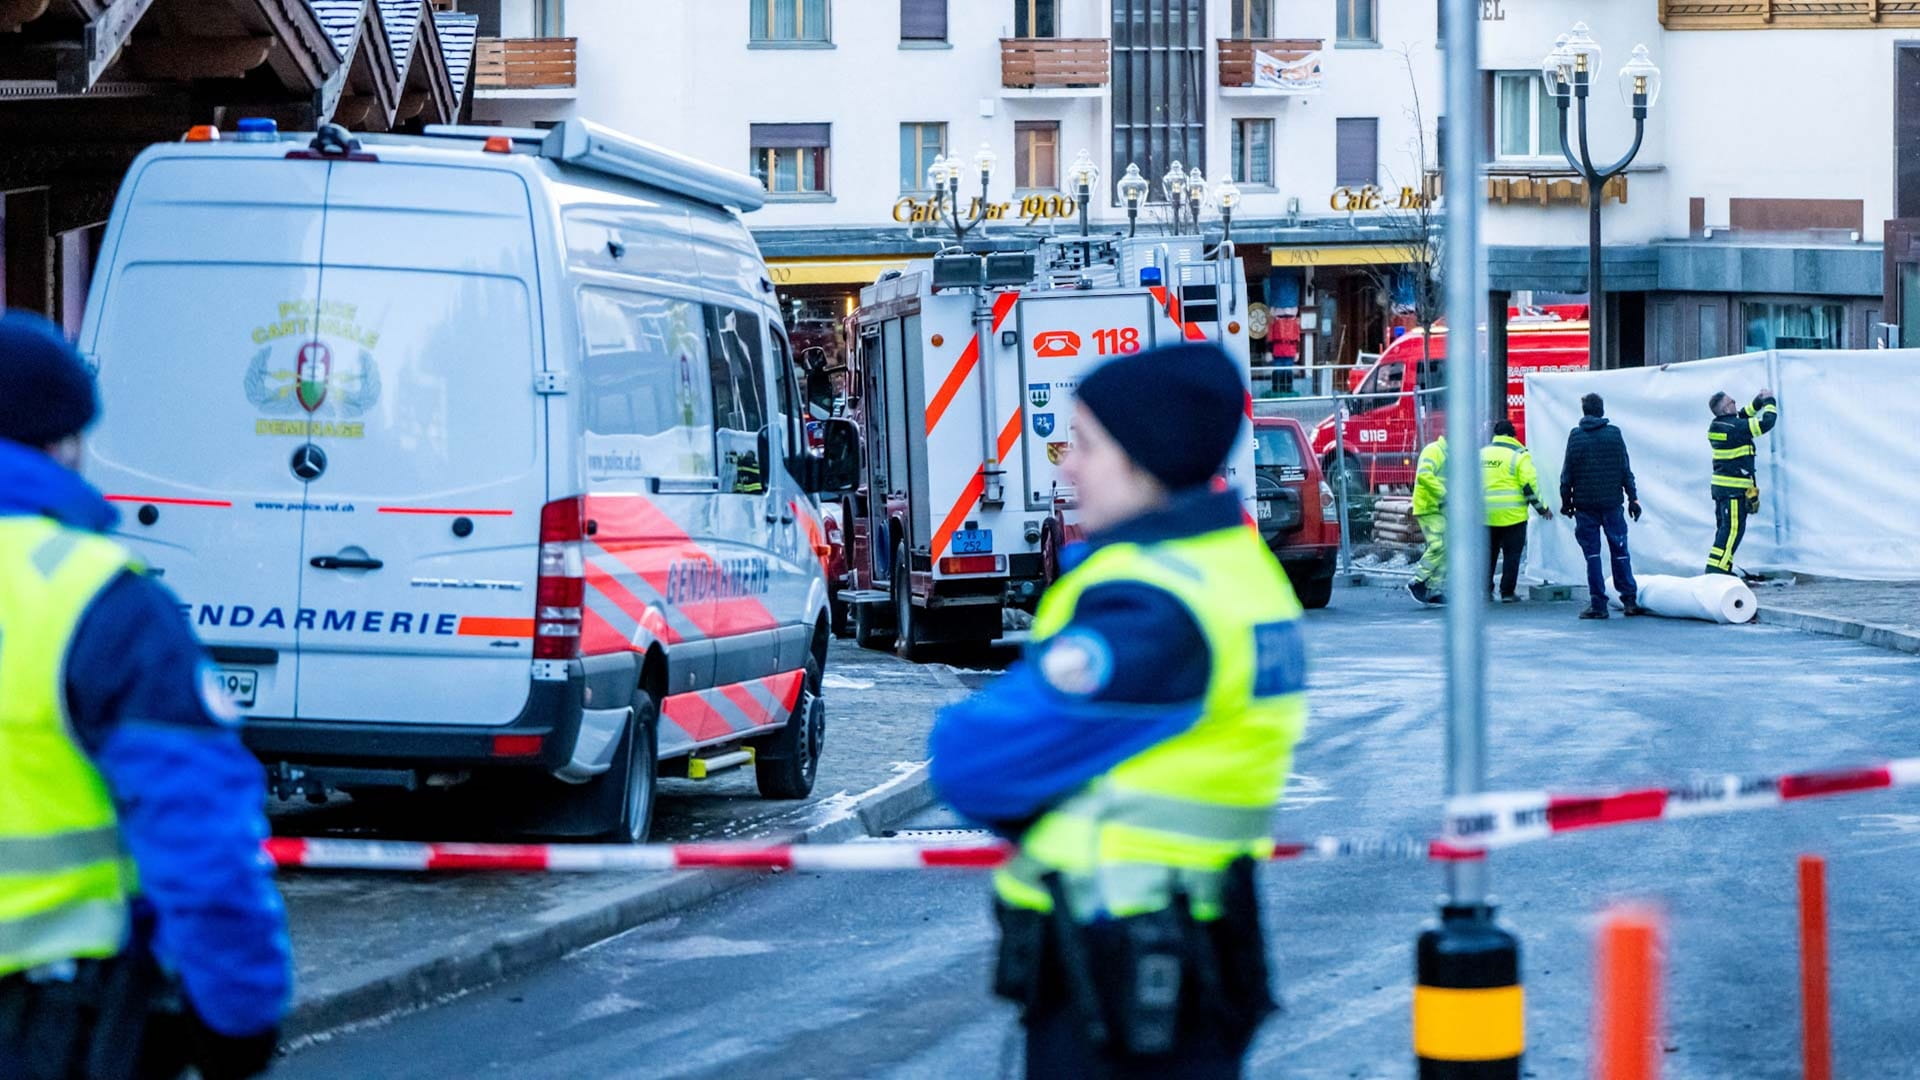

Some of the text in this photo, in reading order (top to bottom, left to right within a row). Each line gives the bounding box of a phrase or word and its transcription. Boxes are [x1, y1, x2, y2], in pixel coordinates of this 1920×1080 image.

[1330, 186, 1381, 211] Café
[1017, 194, 1076, 226] 1900
[768, 267, 791, 282] 00
[279, 301, 357, 320] POLICE
[252, 318, 380, 349] CANTONALE
[1092, 327, 1140, 355] 118
[1370, 429, 1387, 442] 118
[255, 503, 354, 512] www.police.vd.ch
[963, 540, 981, 551] 252
[667, 557, 770, 604] GENDARMERIE
